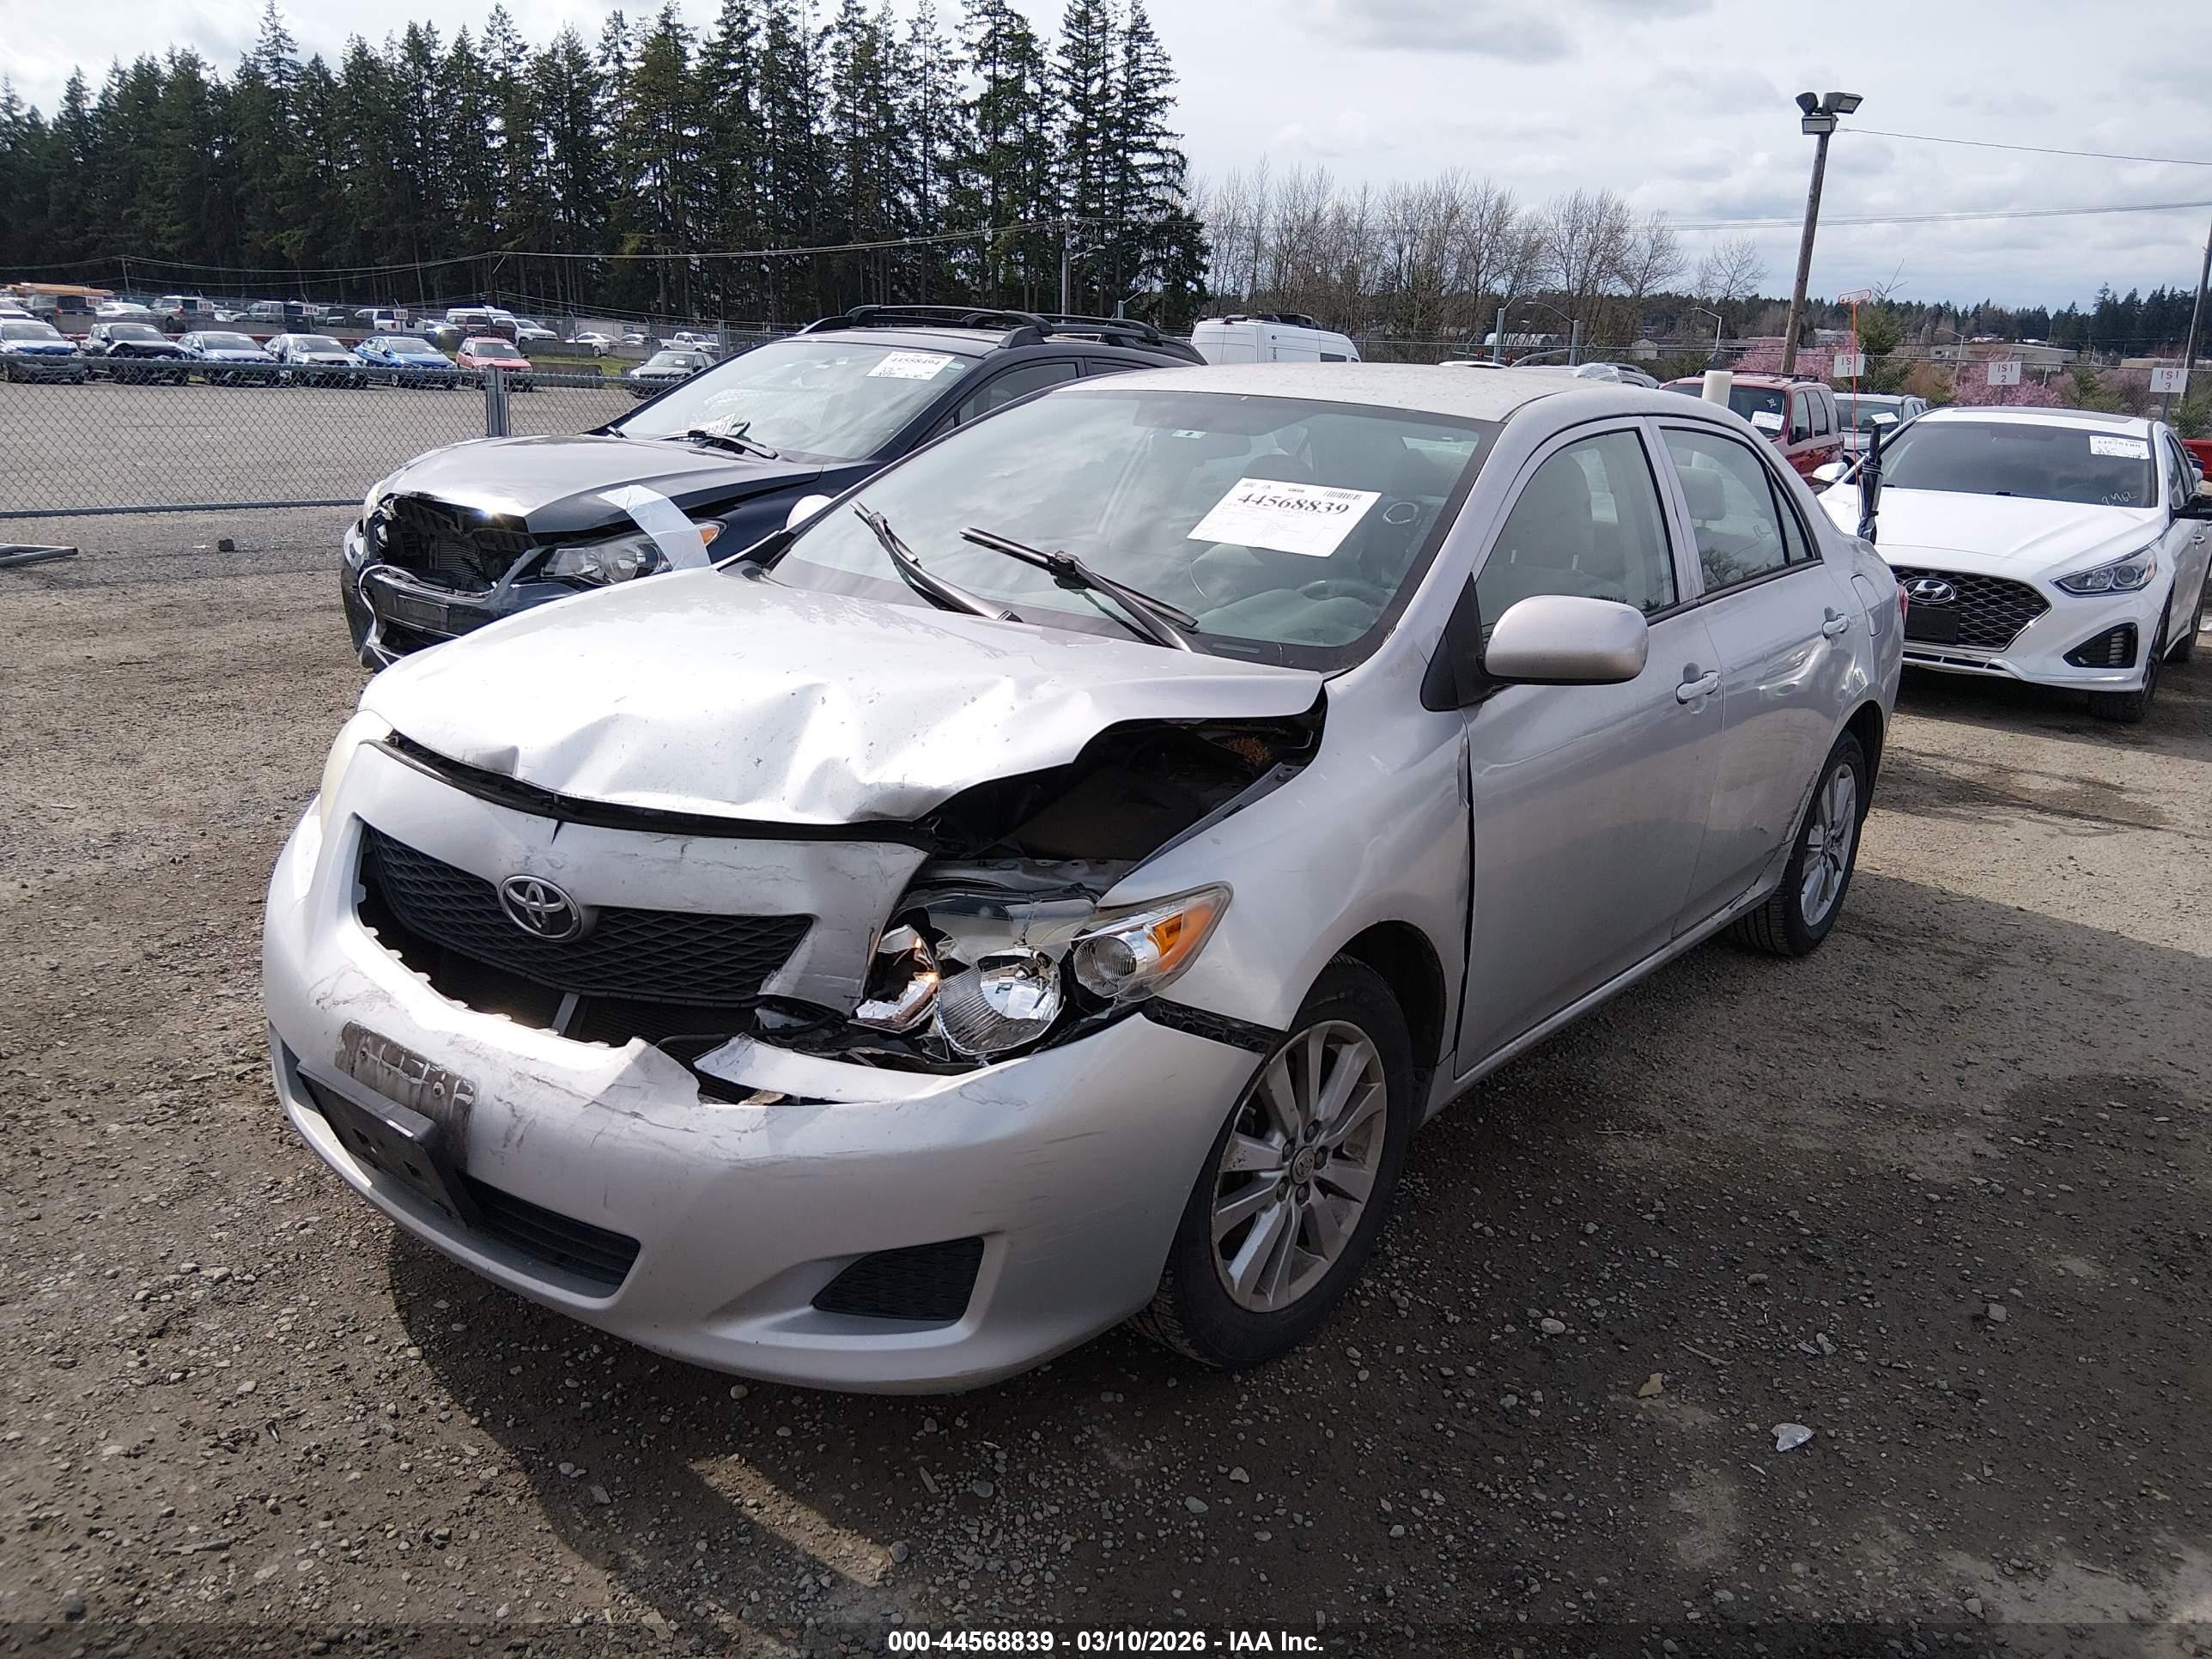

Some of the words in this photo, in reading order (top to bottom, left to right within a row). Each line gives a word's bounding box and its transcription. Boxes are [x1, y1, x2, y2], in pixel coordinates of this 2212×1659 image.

[2000, 374, 2007, 383] 2
[2164, 382, 2172, 391] 3
[1237, 493, 1350, 515] 44568839
